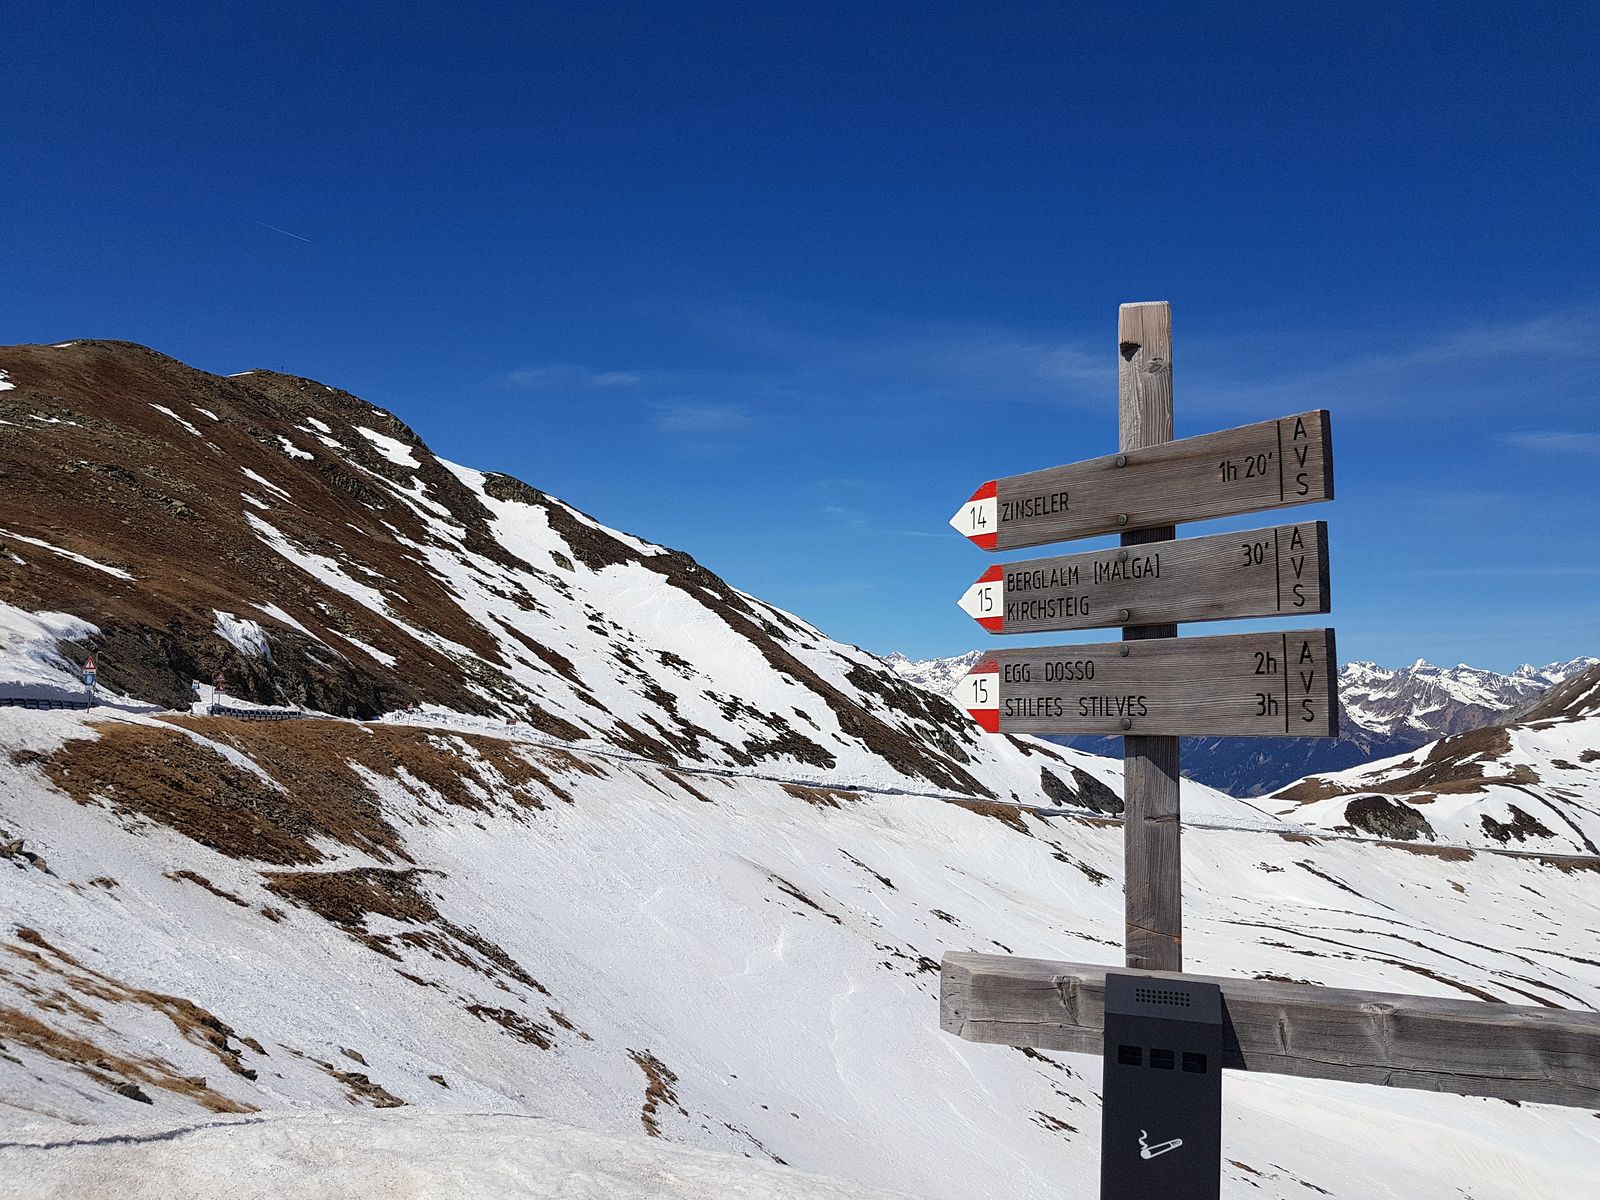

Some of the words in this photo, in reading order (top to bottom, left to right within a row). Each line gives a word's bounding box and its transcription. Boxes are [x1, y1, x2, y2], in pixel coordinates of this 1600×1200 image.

[1219, 461, 1237, 482] 1h
[970, 505, 986, 529] 14
[1001, 492, 1069, 522] ZINSELER
[1007, 565, 1079, 591] BERGLALM
[1094, 553, 1160, 585] [MALGA]
[977, 588, 992, 612] 15
[1007, 596, 1089, 621] KIRCHSTEIG
[1005, 664, 1030, 683] EGG
[1046, 660, 1095, 680] DOSSO
[1255, 652, 1277, 674] 2h
[973, 679, 988, 703] 15
[1005, 697, 1062, 717] STILFES
[1079, 696, 1147, 716] STILVES
[1256, 693, 1278, 716] 3h
